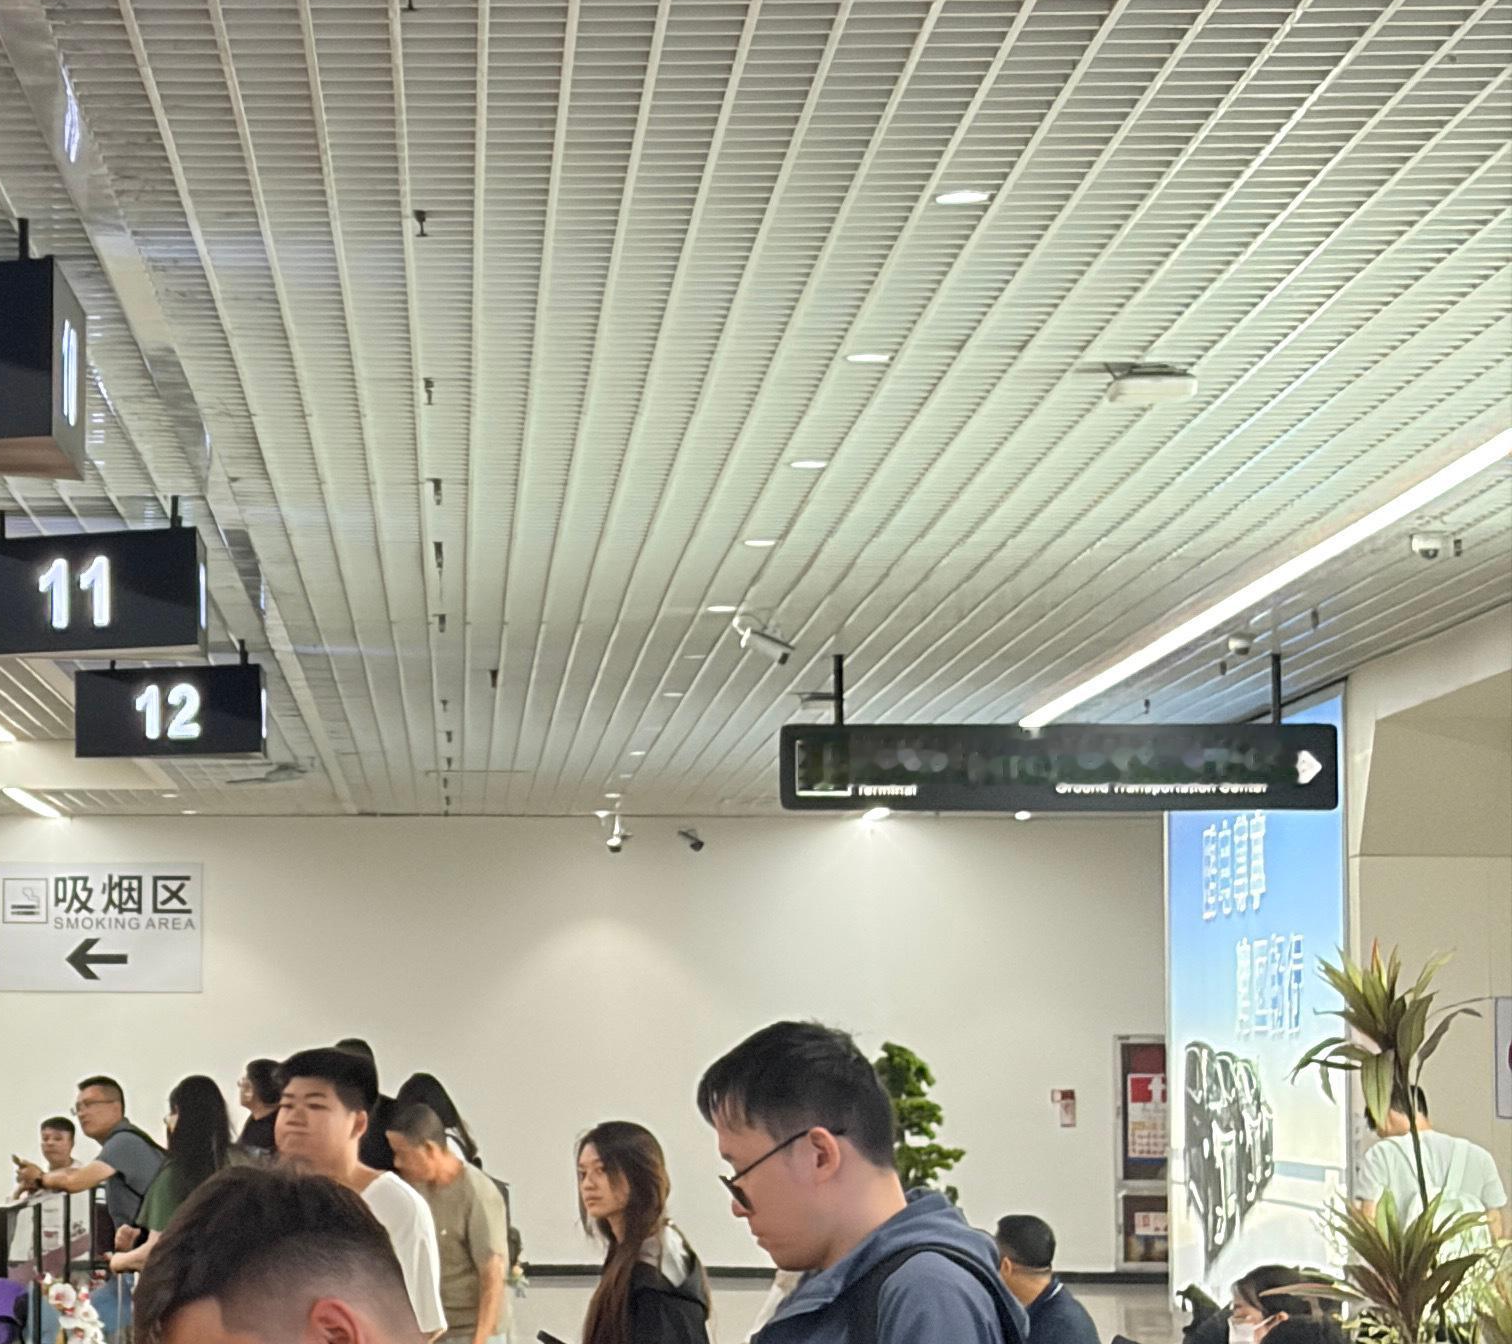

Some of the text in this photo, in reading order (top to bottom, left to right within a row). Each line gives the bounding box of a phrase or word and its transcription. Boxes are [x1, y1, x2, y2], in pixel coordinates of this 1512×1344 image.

[38, 555, 111, 630] 11
[135, 682, 202, 740] 12
[54, 873, 193, 915] 吸烟区
[54, 916, 197, 931] SMOKING AREA
